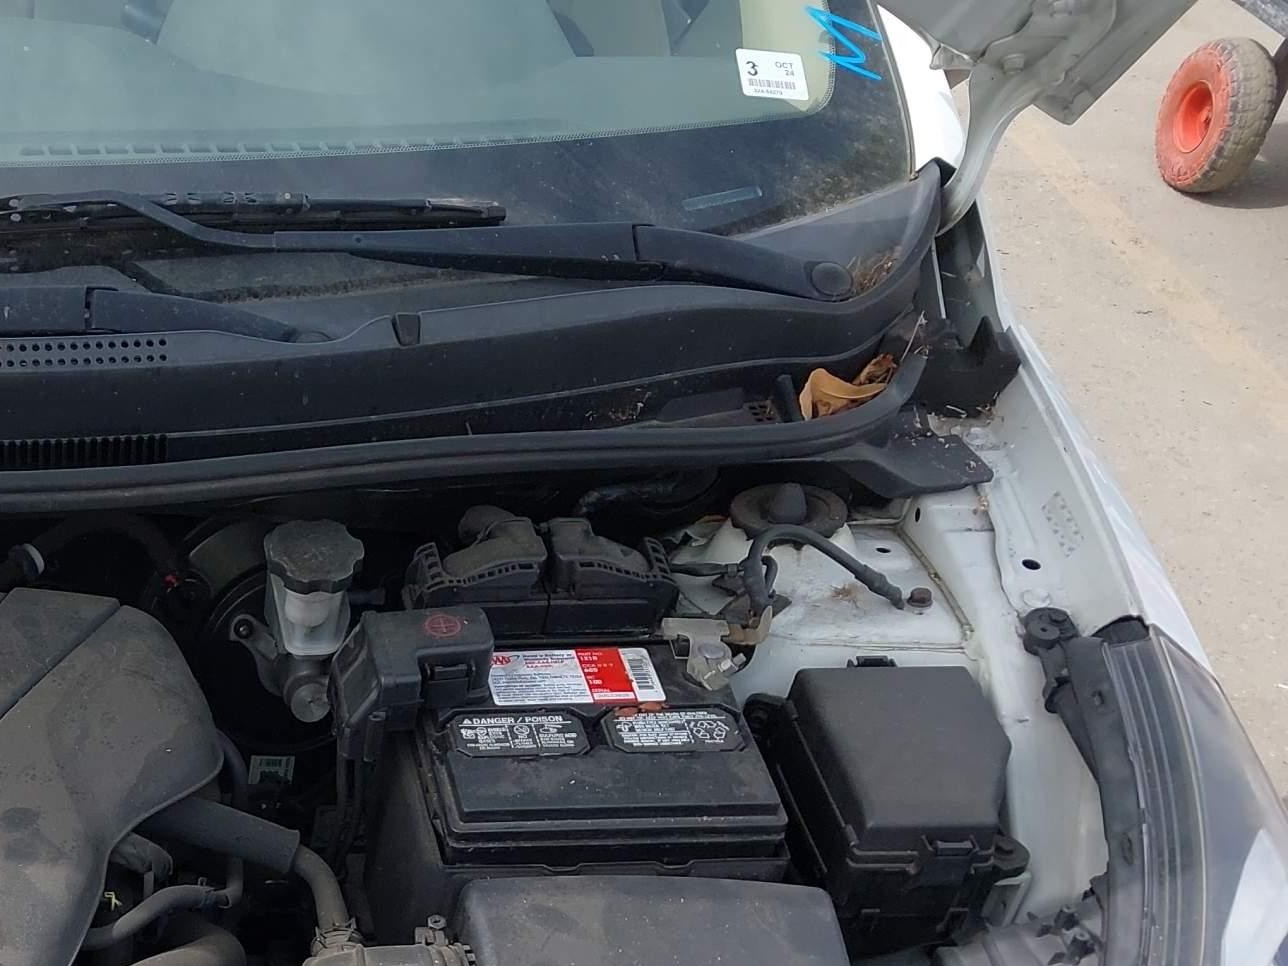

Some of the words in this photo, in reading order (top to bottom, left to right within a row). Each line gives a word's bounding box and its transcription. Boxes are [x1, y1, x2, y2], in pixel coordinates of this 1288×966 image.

[745, 60, 759, 77] 3
[775, 61, 793, 69] OCT
[473, 717, 514, 725] DANGER
[525, 715, 563, 723] POISON
